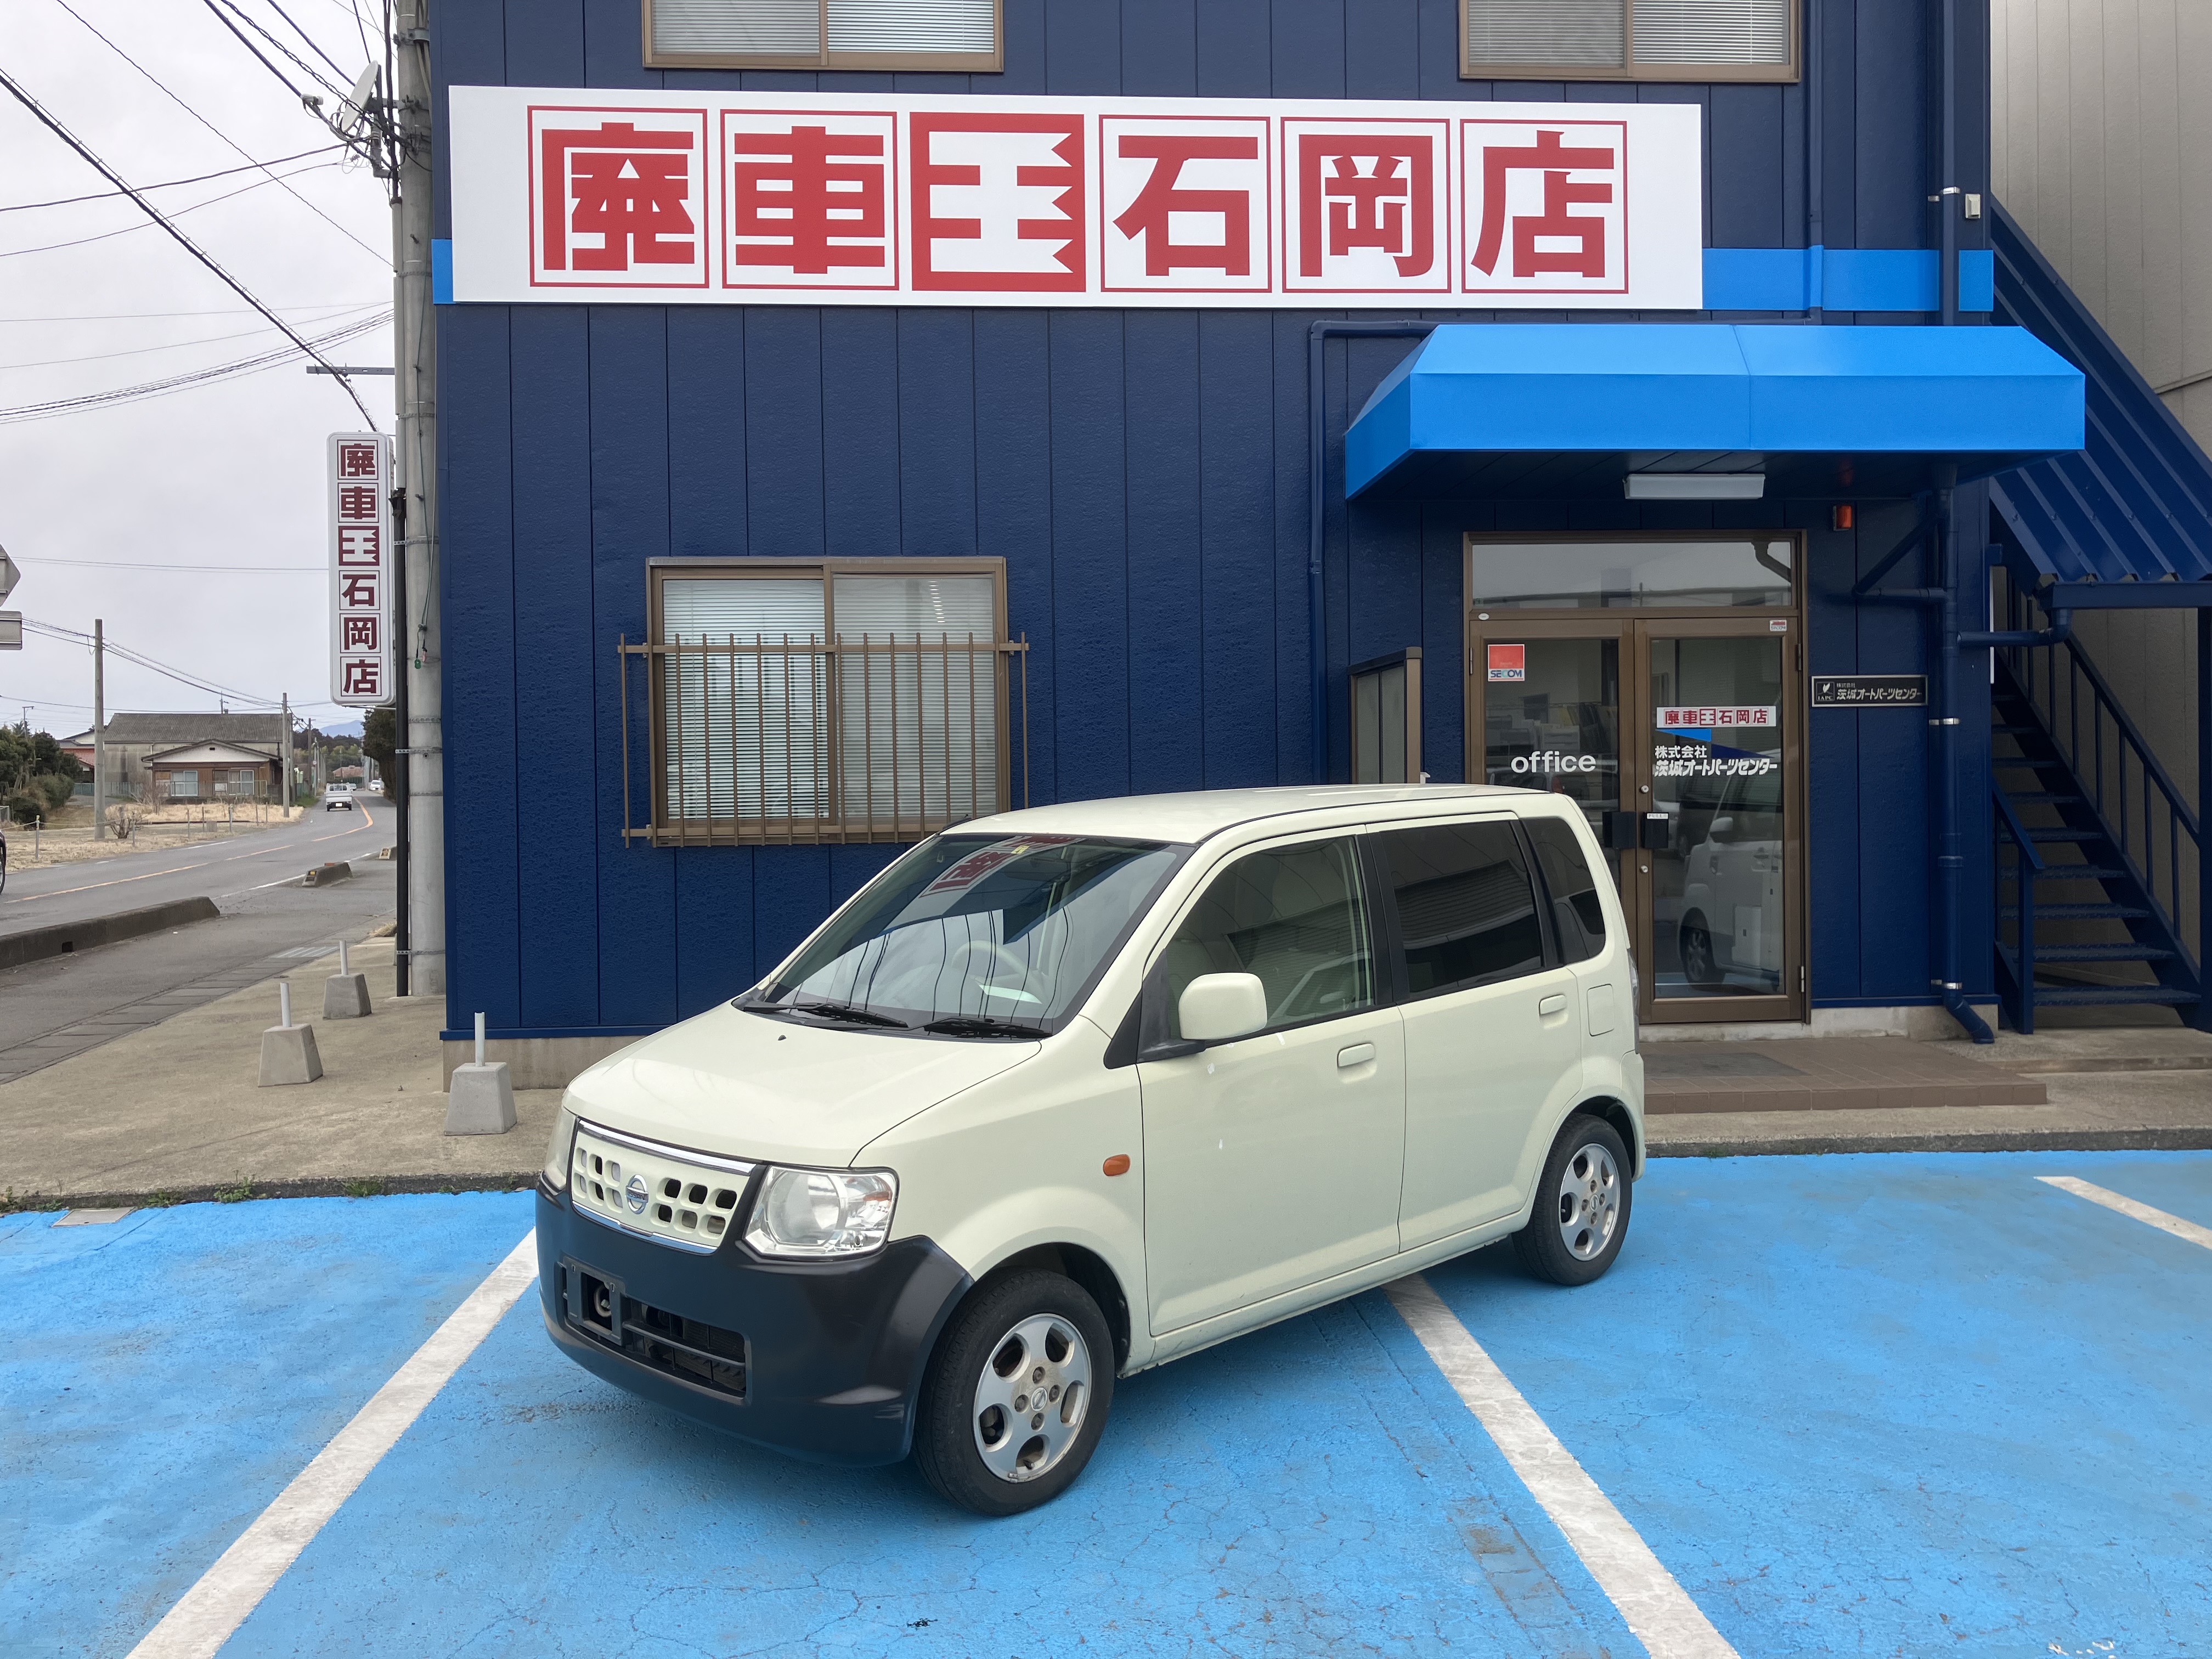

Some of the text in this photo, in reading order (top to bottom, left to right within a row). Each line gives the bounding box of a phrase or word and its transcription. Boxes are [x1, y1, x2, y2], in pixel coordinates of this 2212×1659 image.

[540, 111, 1616, 292] 廃車王石岡店
[338, 442, 380, 695] 廃車王石岡店
[1490, 669, 1522, 678] SECOM
[1836, 688, 1922, 700] 茨城オートパーツセンター
[1664, 708, 1768, 726] 廃車王石岡店
[1655, 745, 1707, 759] 株式会社
[1511, 751, 1596, 773] office
[1654, 758, 1778, 777] 茨城オートパーツセンター
